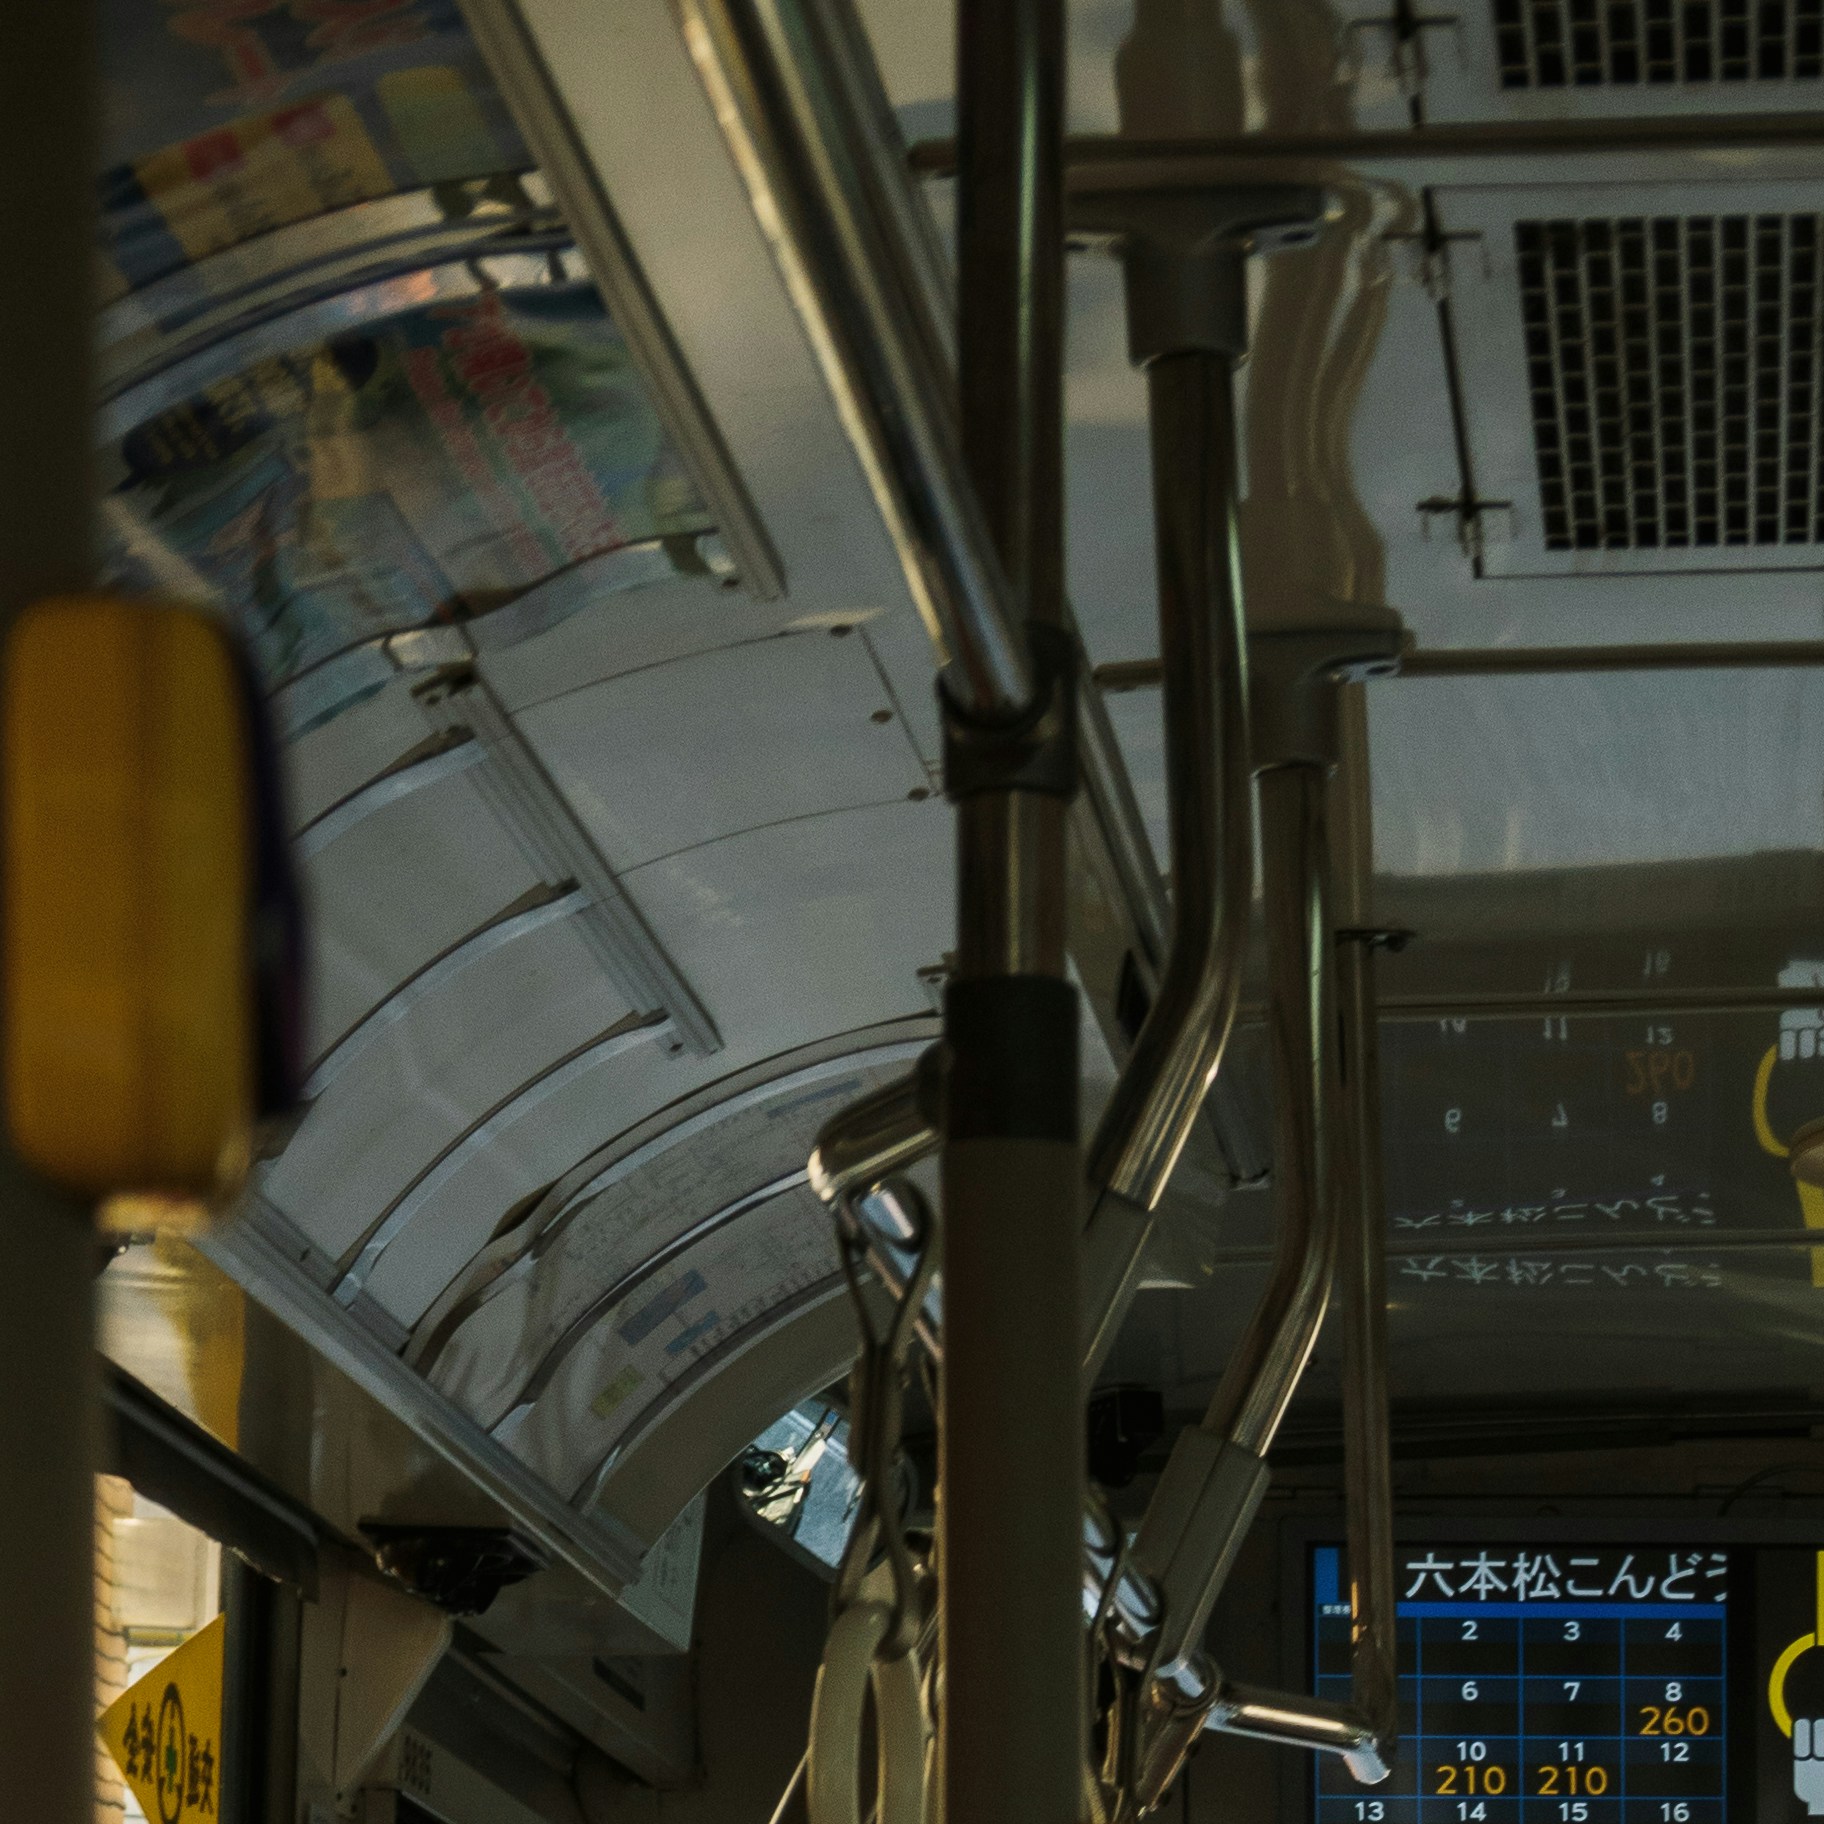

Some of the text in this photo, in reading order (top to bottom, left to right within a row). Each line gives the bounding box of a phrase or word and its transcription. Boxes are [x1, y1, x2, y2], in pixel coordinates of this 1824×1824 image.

[1462, 1622, 1479, 1642] 2
[1563, 1622, 1580, 1642] 3
[1664, 1622, 1683, 1642] 4
[1462, 1682, 1478, 1702] 6
[1563, 1682, 1580, 1702] 7
[1665, 1682, 1682, 1702] 8
[1639, 1706, 1710, 1737] 260
[1456, 1742, 1486, 1763] 10
[1557, 1742, 1586, 1763] 11
[1660, 1742, 1690, 1763] 12
[1435, 1766, 1507, 1796] 210
[1536, 1766, 1608, 1796] 210
[1354, 1801, 1385, 1823] 13
[1456, 1802, 1487, 1823] 14
[1558, 1802, 1588, 1823] 15
[1660, 1802, 1690, 1823] 16
